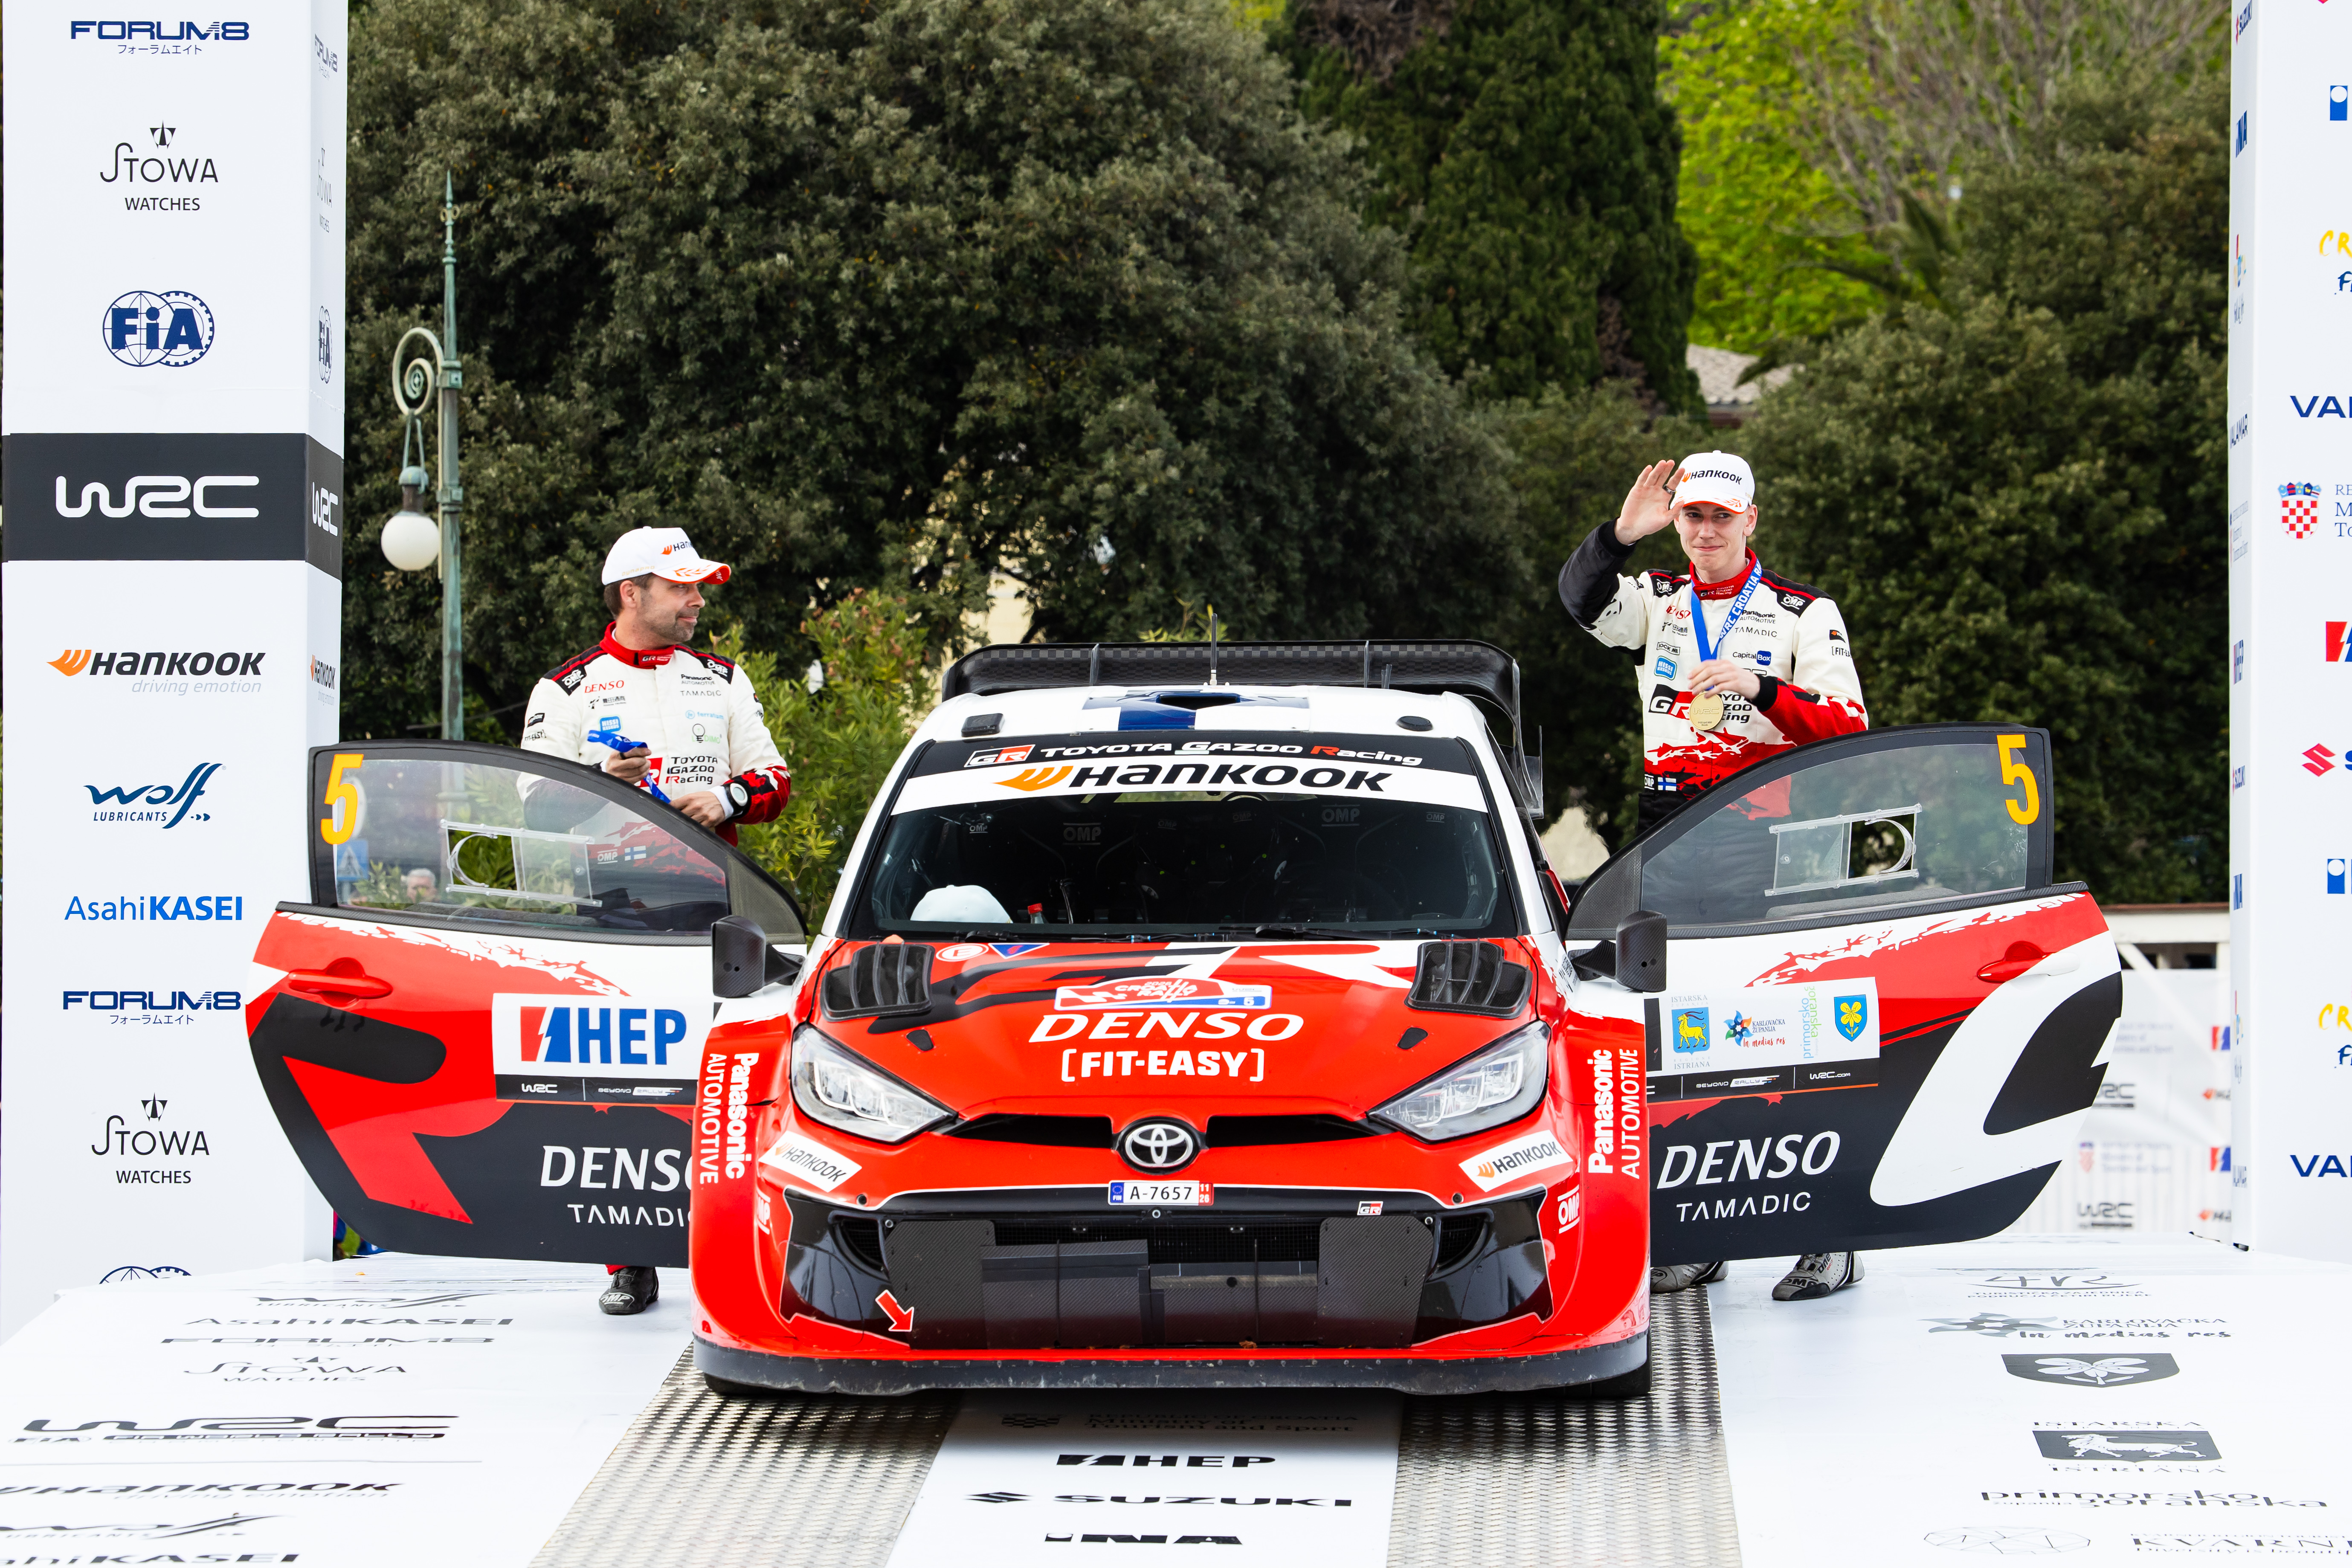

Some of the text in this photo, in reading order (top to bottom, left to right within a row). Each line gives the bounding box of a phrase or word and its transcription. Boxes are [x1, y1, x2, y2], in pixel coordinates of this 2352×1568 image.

[71, 21, 249, 40] FORUM8
[117, 44, 203, 55] フォーラムエイト
[100, 142, 219, 183] STOWA
[125, 197, 200, 211] WATCHES
[56, 476, 259, 518] WRC
[312, 481, 339, 536] WRC
[1719, 576, 1760, 639] WRC CROATIA
[1783, 596, 1804, 607] OMP
[1740, 616, 1776, 624] AUTOMOTIVE
[1741, 610, 1776, 618] Panasonic
[1734, 626, 1777, 638] TAMADIC
[132, 679, 261, 696] driving emotion
[585, 680, 625, 693] DENSO
[671, 755, 718, 765] TOYOTA
[1040, 742, 1172, 757] TOYOTA
[1181, 742, 1303, 754] GAZOO
[1311, 745, 1423, 766] Racing
[667, 765, 715, 774] GAZOO
[665, 774, 713, 784] Racing
[1996, 733, 2041, 826] 5
[320, 754, 364, 845] 5
[93, 812, 167, 822] LUBRICANTS
[1321, 808, 1360, 825] OMP
[1063, 826, 1102, 841] OMP
[597, 852, 618, 862] OMP
[64, 896, 242, 920] AsahiKASEI
[63, 991, 241, 1010] FORUM8
[1671, 994, 1708, 1003] ISTARSKA
[1804, 985, 1822, 1038] goranska
[109, 1015, 194, 1025] フォーラムエイト
[1028, 1012, 1304, 1043] DENSO
[1752, 1018, 1786, 1029] KARLOVAČKA
[1798, 997, 1814, 1059] primorsko
[578, 1008, 687, 1065] HEP
[1752, 1038, 1775, 1048] medias
[1776, 1037, 1786, 1046] res
[1673, 1061, 1711, 1070] ISTRIANA
[521, 1083, 558, 1094] WRC
[700, 1052, 727, 1185] AUTOMOTIVE
[726, 1052, 759, 1180] Panasonic
[1588, 1049, 1614, 1174] Panasonic
[1621, 1049, 1641, 1180] AUTOMOTIVE
[91, 1115, 210, 1155] STOWA
[1656, 1131, 1841, 1189] DENSO
[540, 1145, 693, 1192] DENS
[116, 1171, 191, 1184] WATCHES
[1130, 1186, 1192, 1200] A-7657
[1199, 1183, 1209, 1192] 11
[1199, 1194, 1210, 1203] 26
[1359, 1202, 1382, 1215] GR
[1558, 1193, 1580, 1226] OMP
[1676, 1191, 1811, 1222] TAMADIC
[567, 1203, 690, 1227] TAMADI
[1132, 1455, 1276, 1468] HEP
[1053, 1494, 1351, 1507] SUZUKI
[1981, 1489, 2259, 1501] primorsko
